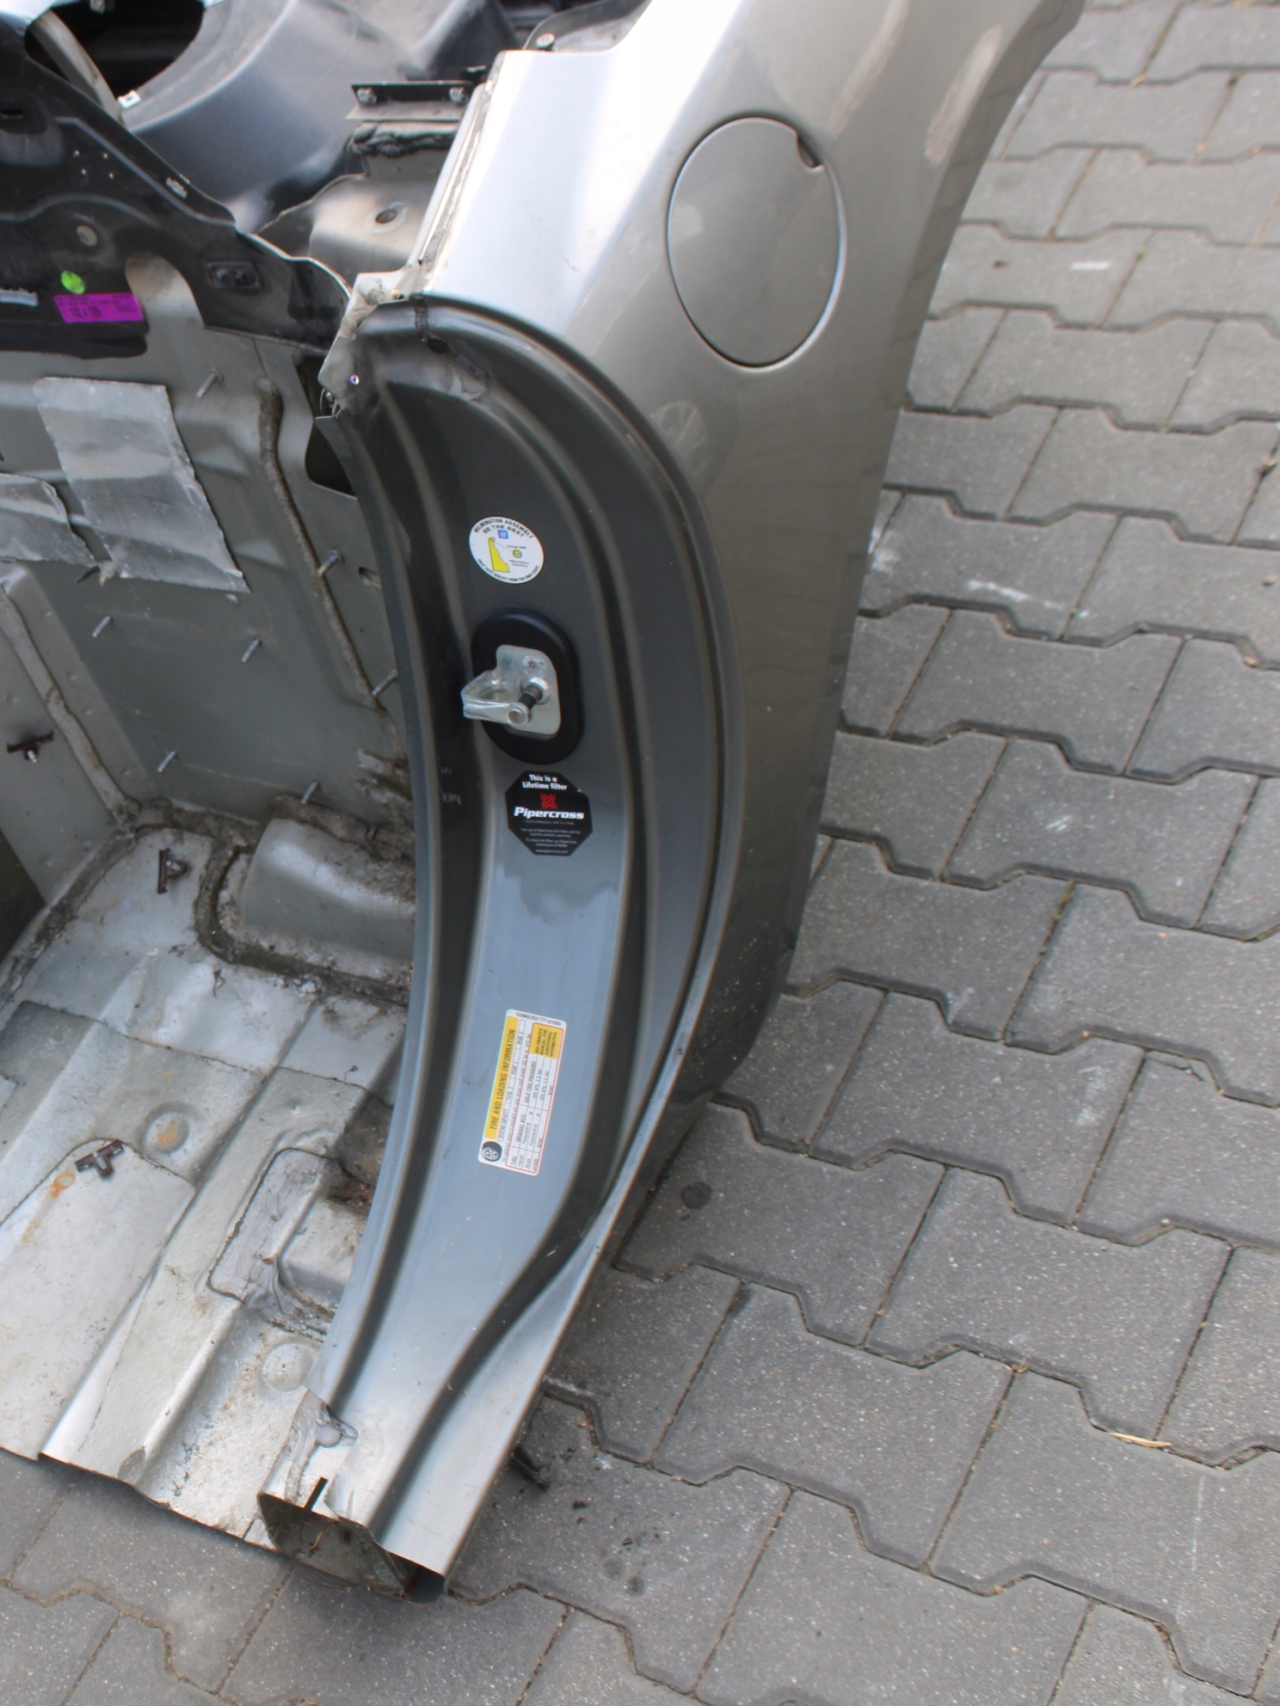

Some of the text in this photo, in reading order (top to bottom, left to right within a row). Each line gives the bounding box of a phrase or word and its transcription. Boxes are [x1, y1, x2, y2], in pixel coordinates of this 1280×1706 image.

[504, 520, 534, 538] ASSEMBLY
[522, 781, 568, 790] Lifetime filter
[514, 806, 585, 820] Pipercross
[490, 1028, 516, 1130] TIRE AND LOADING INFORMATION
